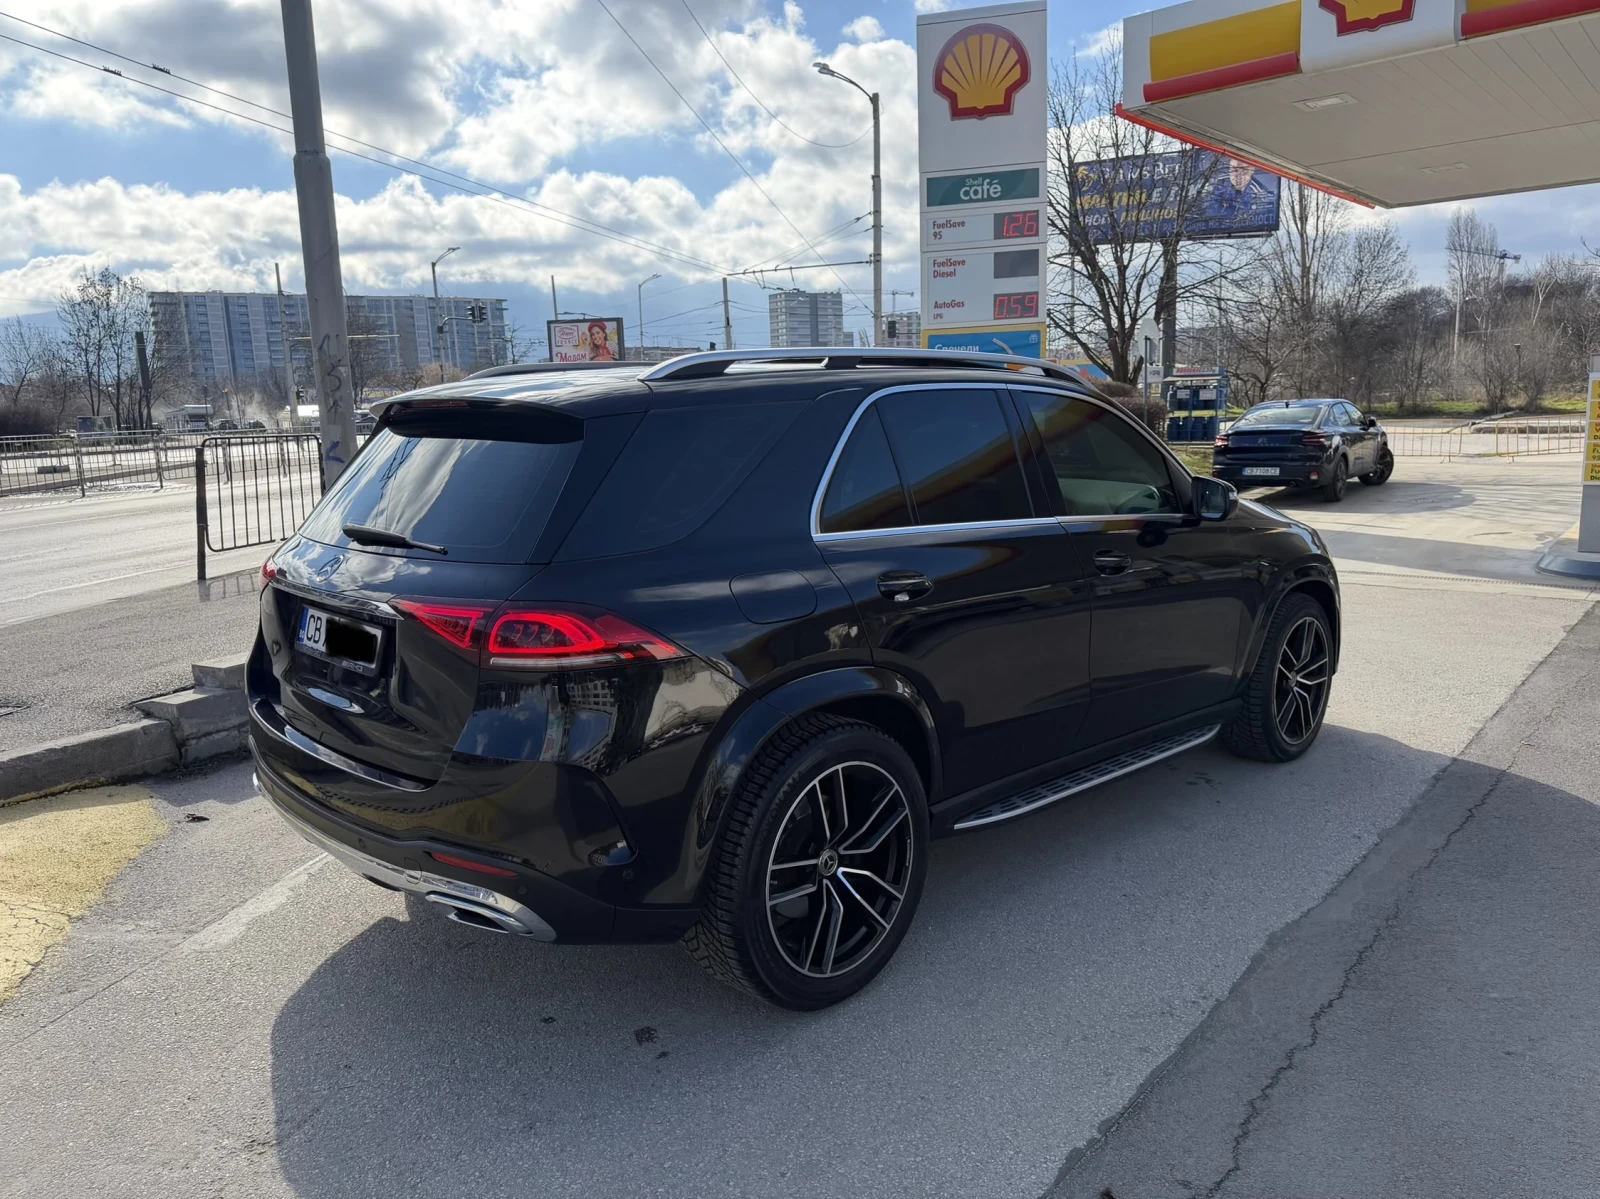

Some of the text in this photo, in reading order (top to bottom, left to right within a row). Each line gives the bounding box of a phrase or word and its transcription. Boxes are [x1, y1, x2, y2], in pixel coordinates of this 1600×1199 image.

[965, 177, 982, 186] Shell
[960, 179, 1001, 200] café
[932, 219, 966, 230] FuelSave
[932, 231, 943, 240] 95
[932, 258, 966, 268] FuelSave
[932, 268, 956, 278] Diesel
[933, 299, 965, 309] AutoGas
[994, 294, 1038, 319] 0.59
[306, 613, 322, 644] CB
